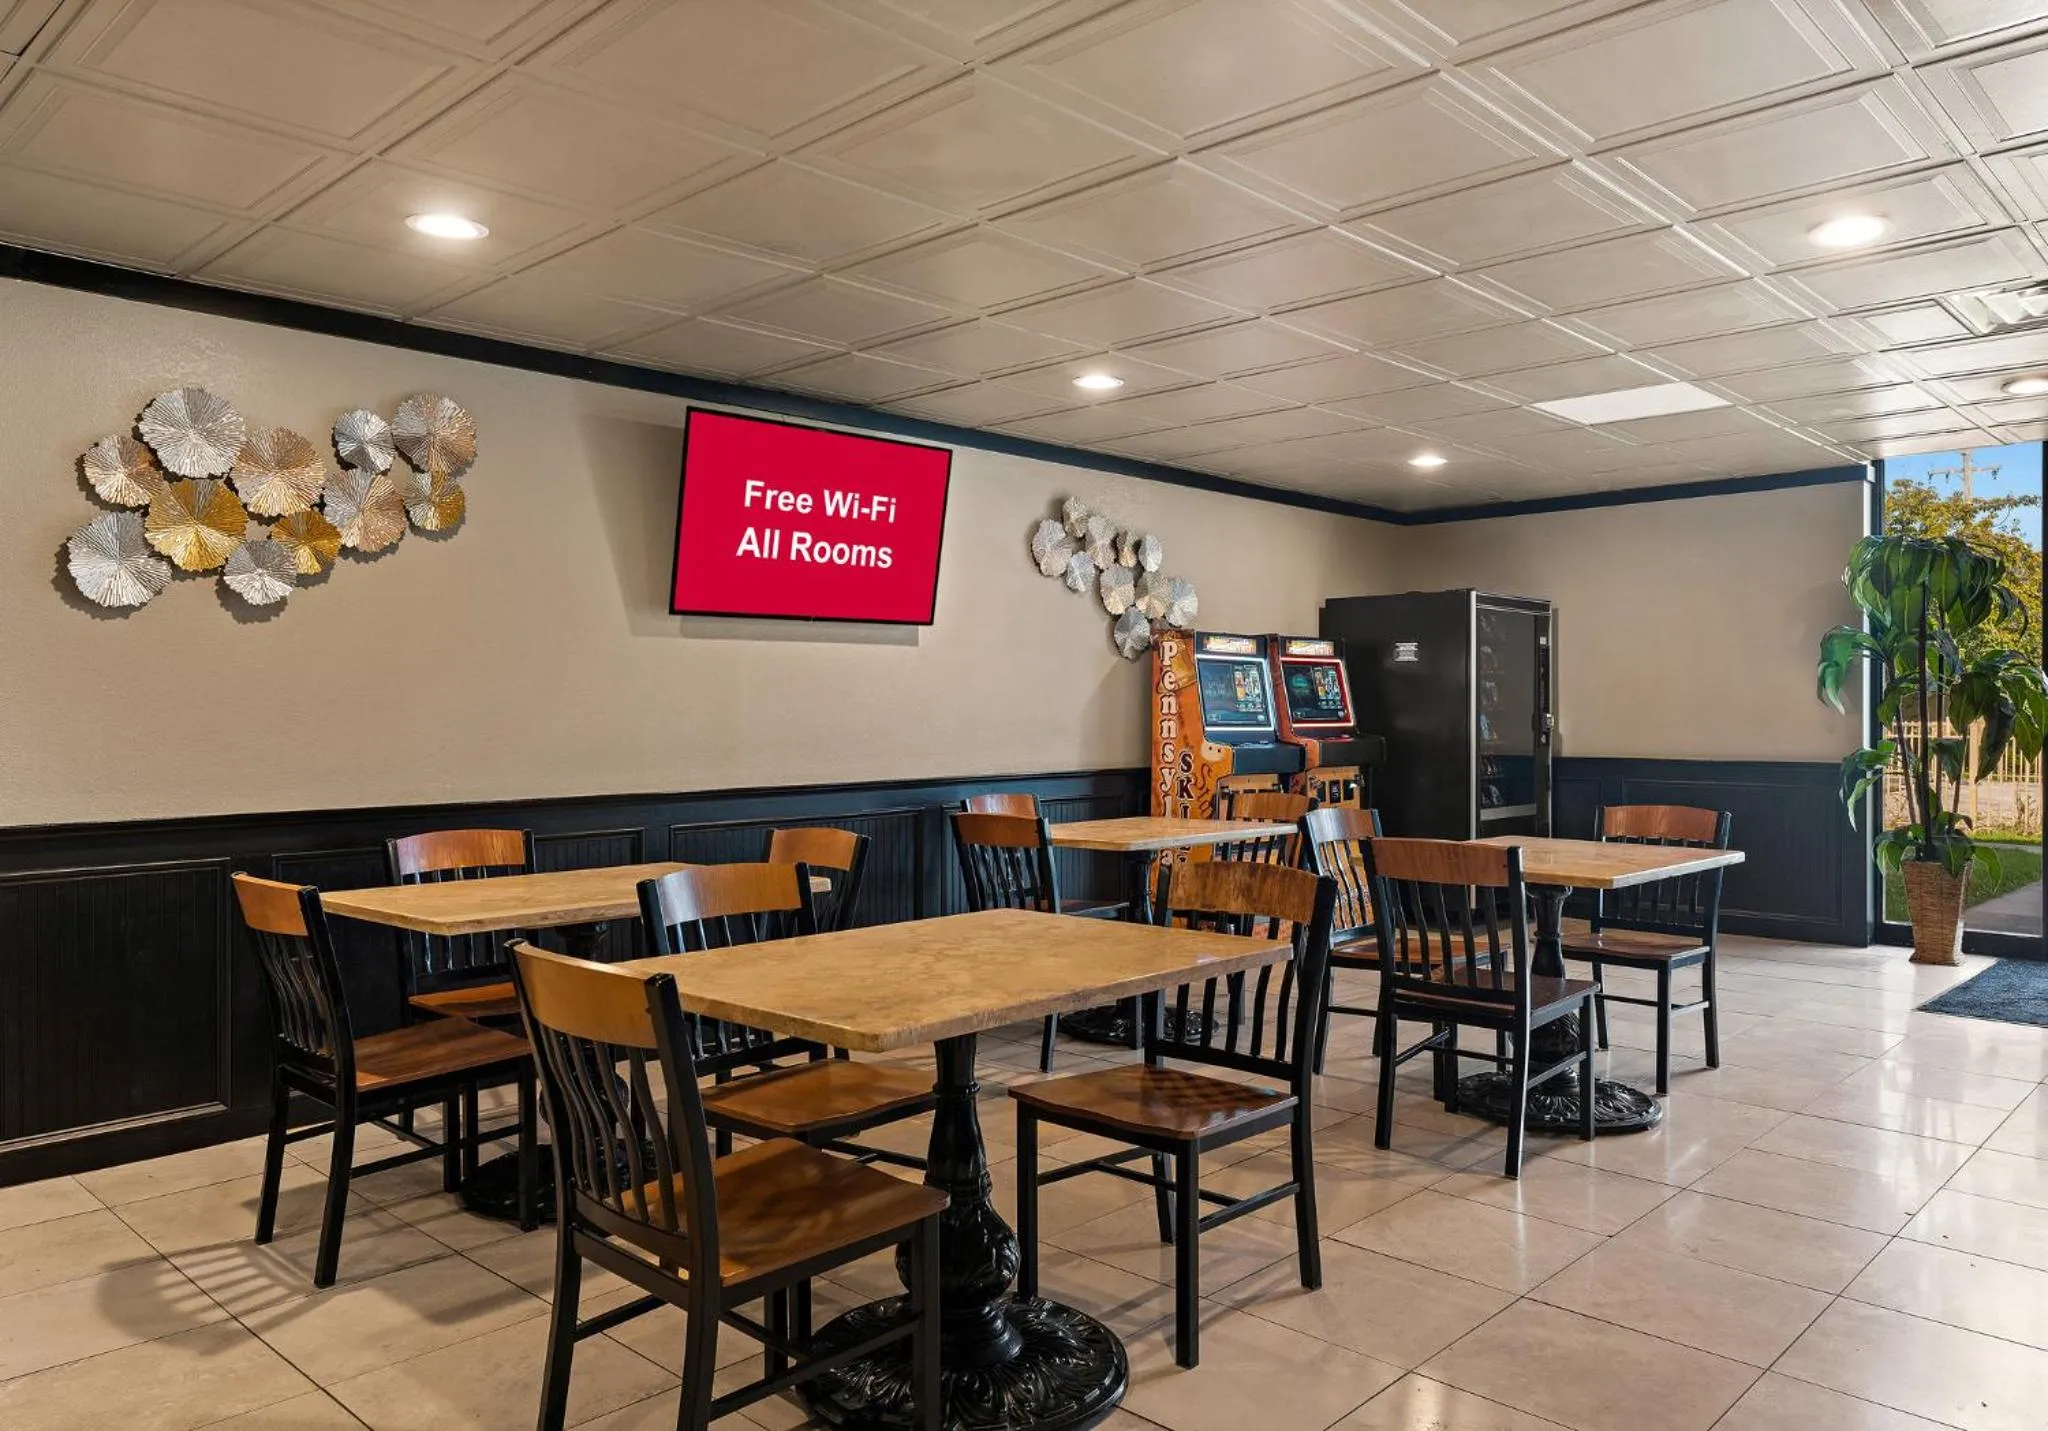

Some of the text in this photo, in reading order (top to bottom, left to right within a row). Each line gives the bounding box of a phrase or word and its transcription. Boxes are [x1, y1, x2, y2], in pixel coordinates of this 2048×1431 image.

[743, 479, 897, 523] Free Wi-Fi
[736, 526, 893, 569] All Rooms
[1159, 640, 1178, 865] Pennsyla
